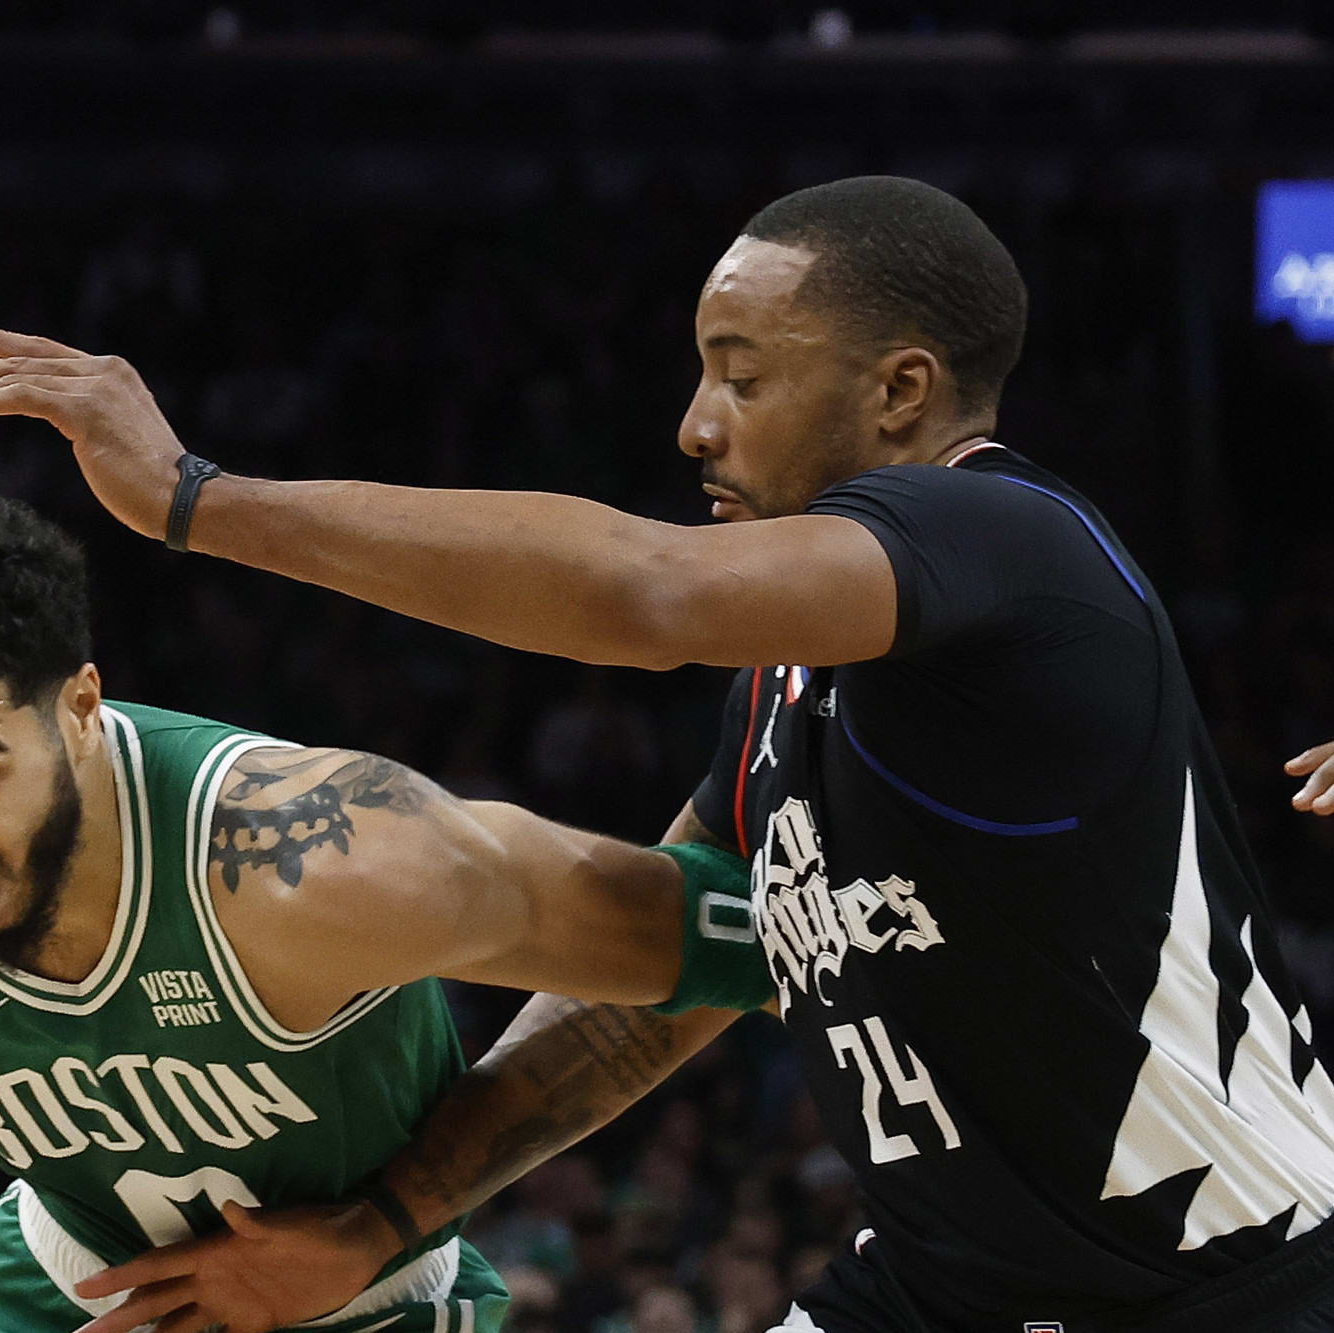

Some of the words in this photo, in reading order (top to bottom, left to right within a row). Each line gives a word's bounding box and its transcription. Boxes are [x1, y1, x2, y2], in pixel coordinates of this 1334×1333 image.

[139, 970, 215, 1001] VISTA
[153, 1002, 222, 1027] PRINT
[825, 1014, 963, 1165] 24
